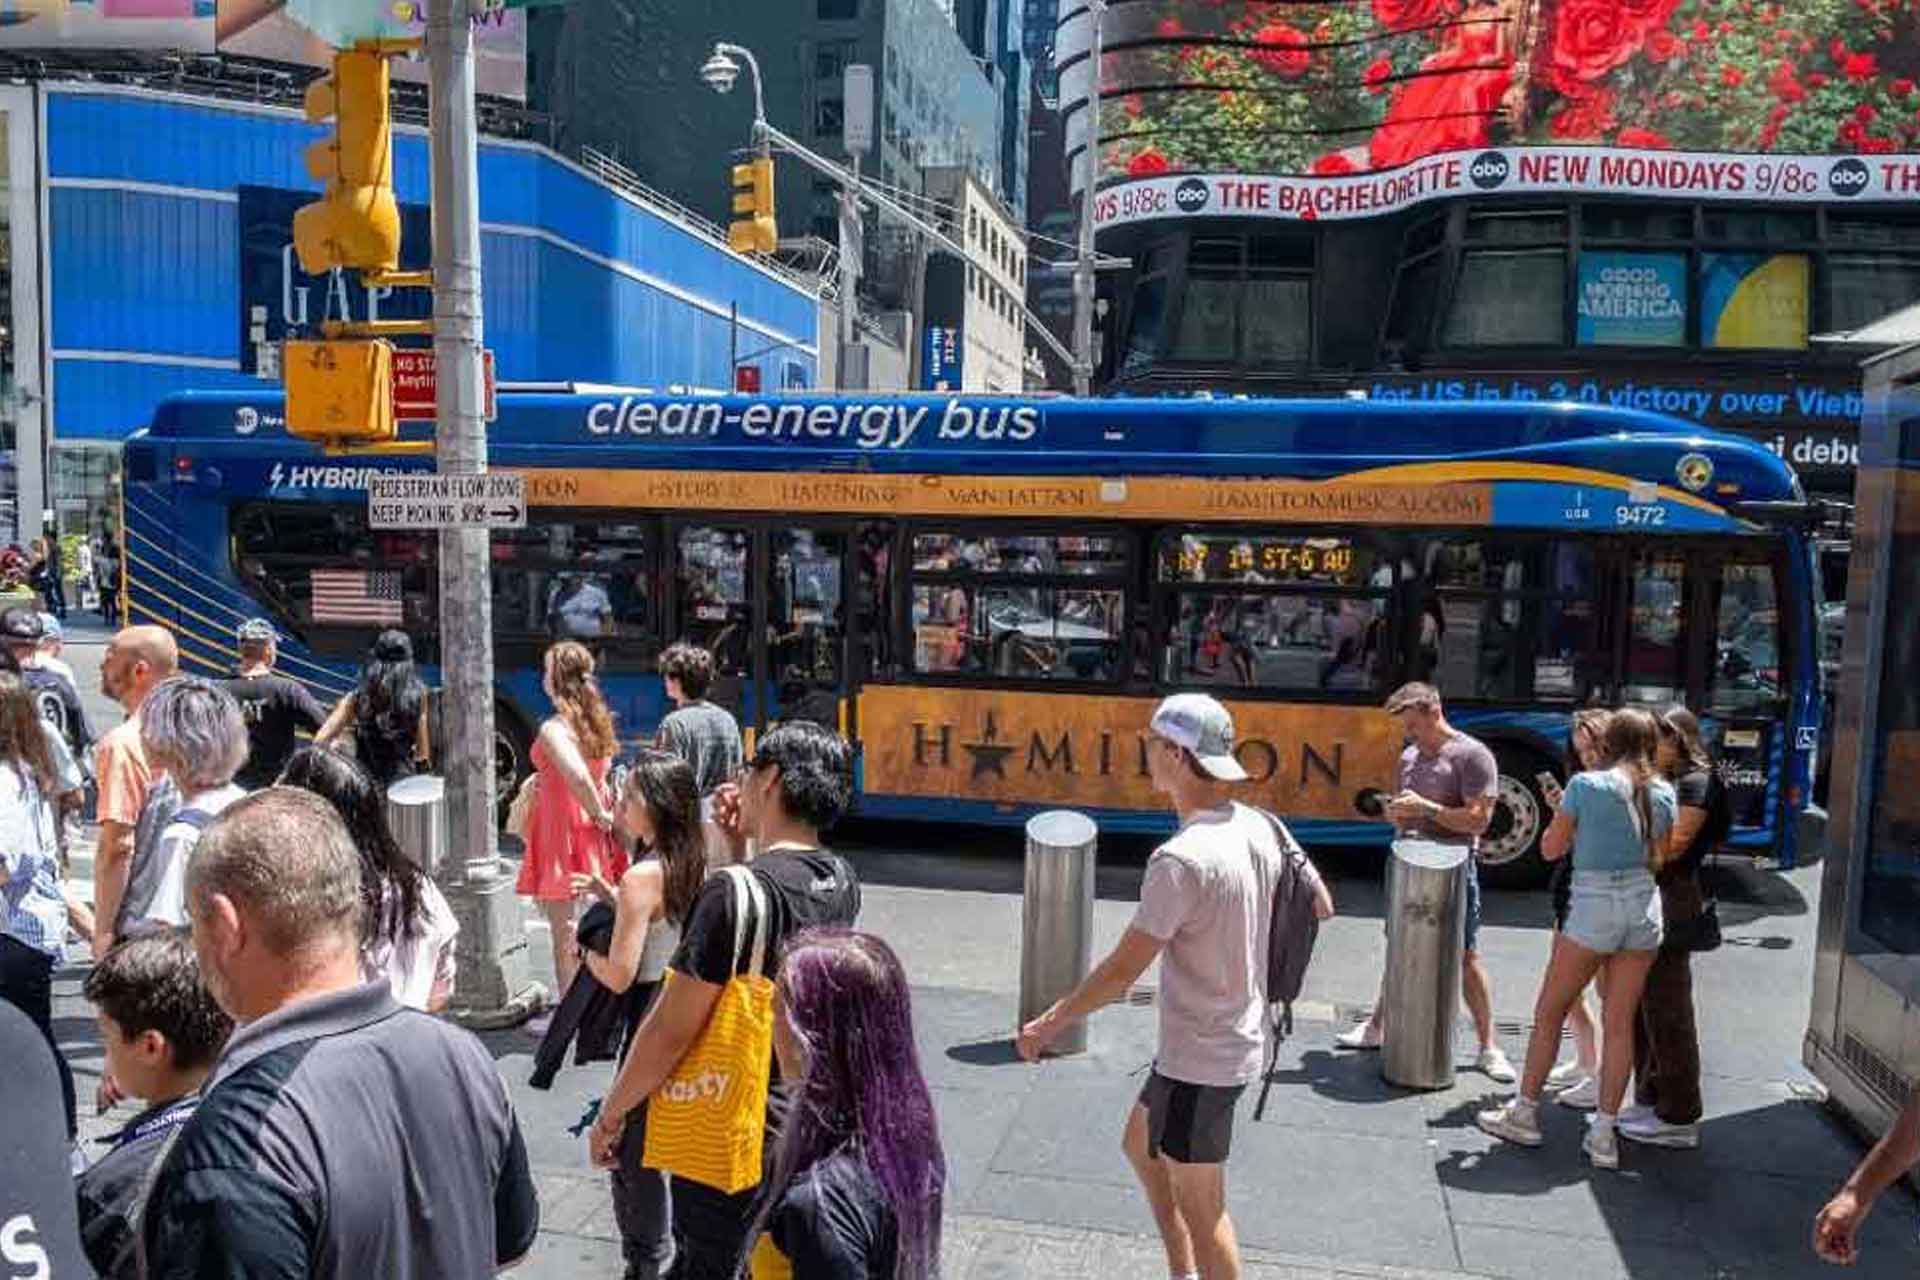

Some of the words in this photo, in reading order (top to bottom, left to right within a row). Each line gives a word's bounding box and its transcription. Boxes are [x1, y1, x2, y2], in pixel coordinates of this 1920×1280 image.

[1176, 184, 1208, 206] abc
[1216, 182, 1271, 209] THE
[1278, 160, 1461, 212] BACHELORETTE
[1471, 158, 1507, 180] abc
[1519, 155, 1590, 183] NEW
[1601, 157, 1746, 190] MONDAYS
[1755, 162, 1817, 196] 9/8c
[1831, 165, 1868, 187] abc
[1577, 300, 1686, 319] AMERICA
[1609, 385, 1712, 416] victory
[1720, 393, 1789, 414] over
[586, 396, 928, 448] clean-energy
[938, 398, 1038, 440] bus
[371, 478, 449, 499] PEDESTRIAN
[452, 477, 486, 498] FLOW
[371, 504, 402, 523] KEEP
[1616, 505, 1666, 526] 9472
[911, 711, 1345, 788] HMION
